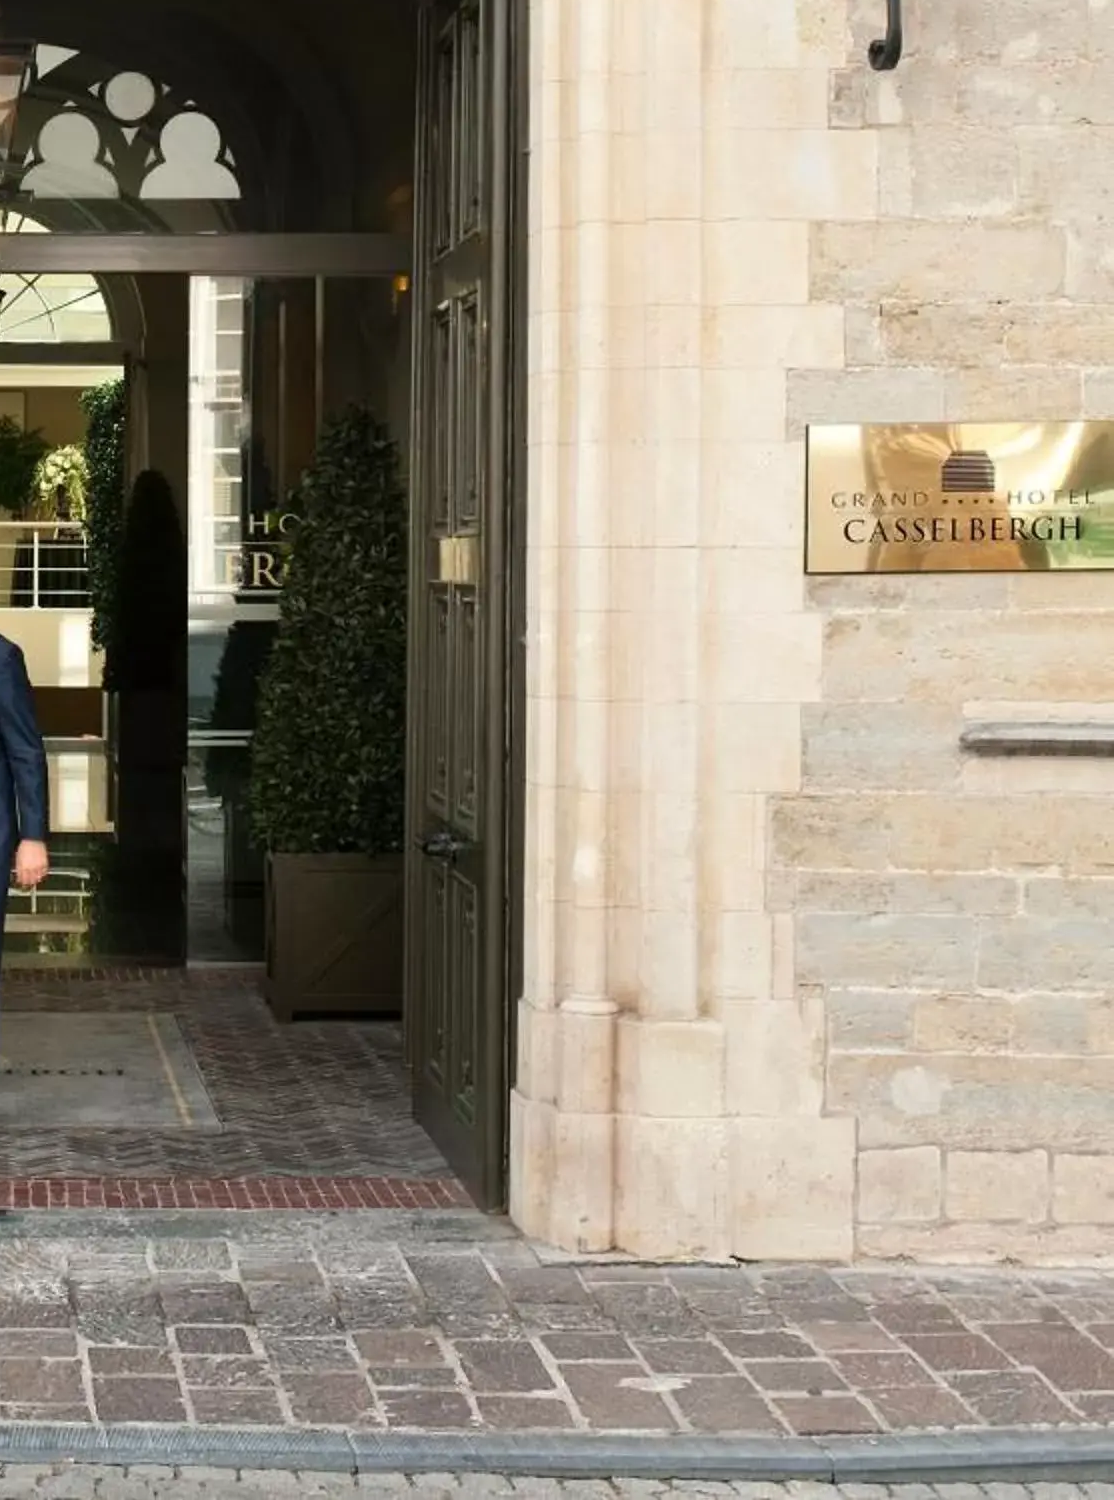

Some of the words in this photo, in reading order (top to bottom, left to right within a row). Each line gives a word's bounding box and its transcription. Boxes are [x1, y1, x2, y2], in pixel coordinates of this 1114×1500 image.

[831, 491, 929, 508] GRAND
[1007, 490, 1095, 505] HOTEL
[843, 516, 1082, 543] CASSELBERGH
[223, 551, 289, 587] ER
